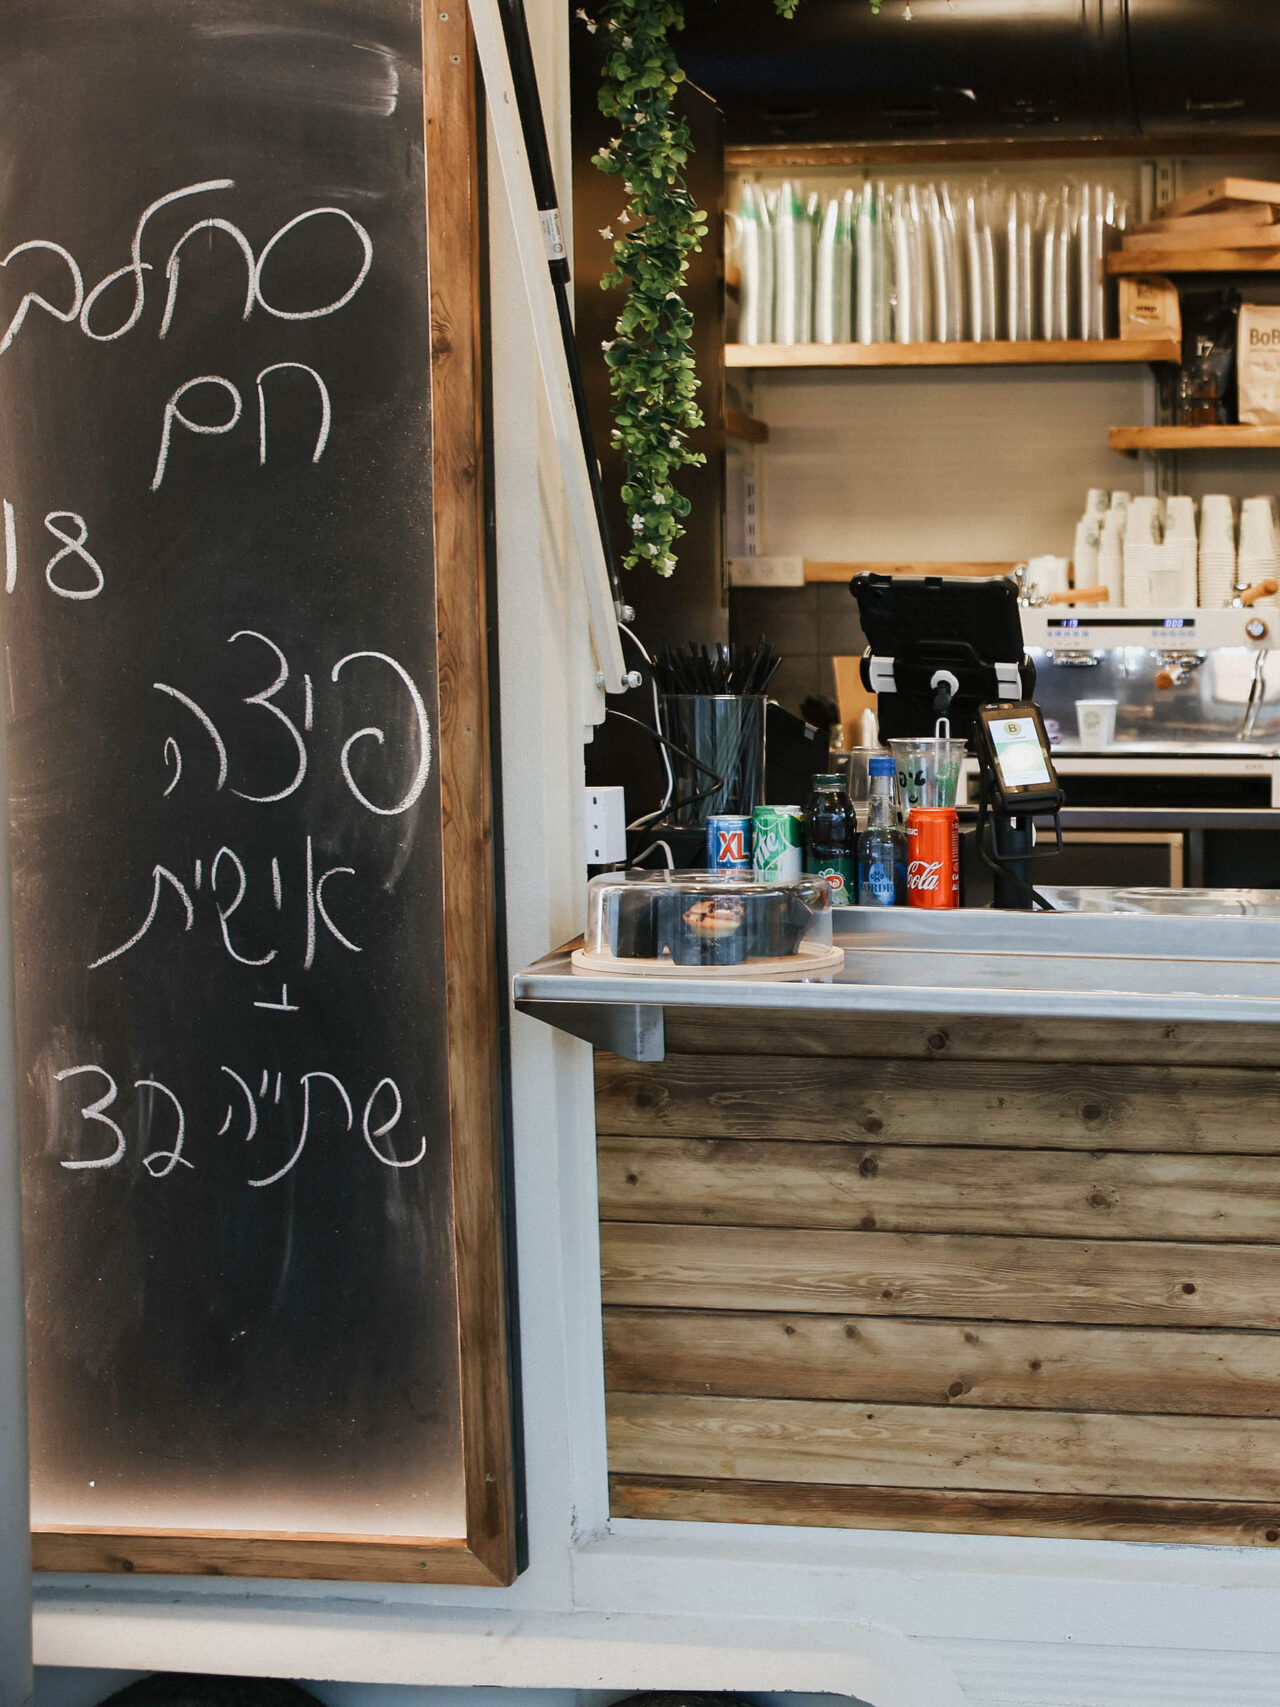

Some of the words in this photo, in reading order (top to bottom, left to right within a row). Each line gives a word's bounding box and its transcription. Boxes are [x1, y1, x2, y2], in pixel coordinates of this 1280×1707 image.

[0, 179, 373, 354] סחלב
[150, 362, 331, 492] חם
[3, 499, 104, 600] 18
[153, 630, 431, 815] פיצה
[1008, 724, 1017, 732] B
[88, 836, 363, 971] אישית
[718, 831, 751, 862] XL
[217, 1065, 427, 1187] שתייה
